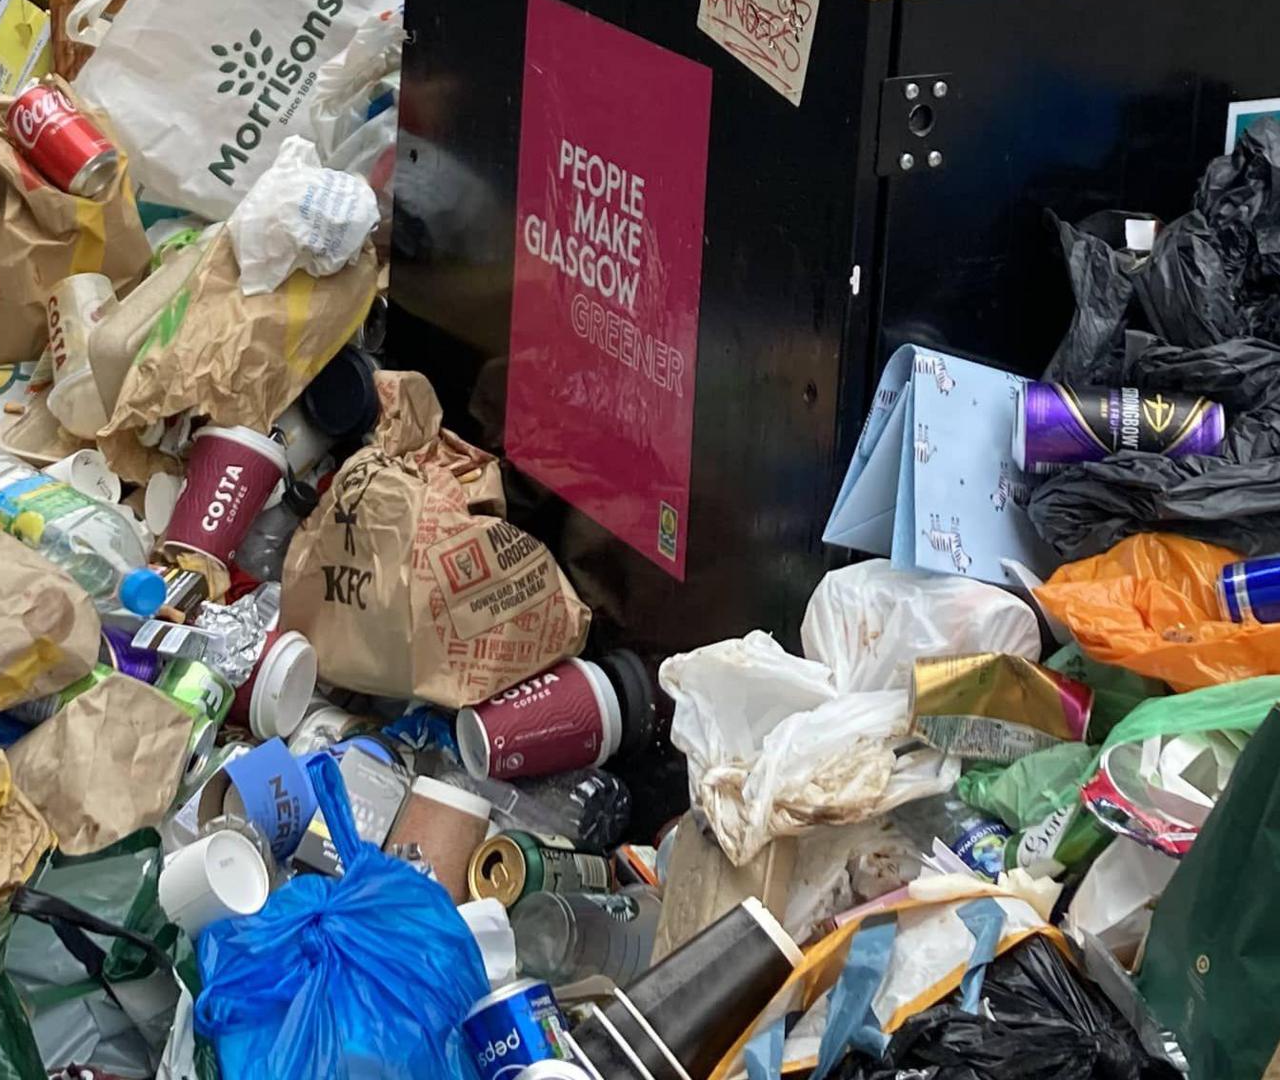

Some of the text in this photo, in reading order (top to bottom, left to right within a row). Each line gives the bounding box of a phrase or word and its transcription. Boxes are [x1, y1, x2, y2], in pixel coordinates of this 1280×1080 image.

[278, 71, 318, 127] Since 1899
[560, 138, 645, 220] PEOPLE
[574, 193, 643, 267] MAKE
[524, 213, 642, 313] GLASGOW
[47, 295, 68, 371] COSTA
[570, 293, 686, 399] GREENER
[202, 464, 244, 532] COSTA
[226, 485, 249, 523] COFFEE
[321, 565, 373, 611] KFC
[470, 584, 514, 613] DOWNLOAD
[489, 578, 547, 617] TO ORDER AHEAD
[491, 673, 561, 705] COSTA
[513, 689, 552, 709] COFFEE
